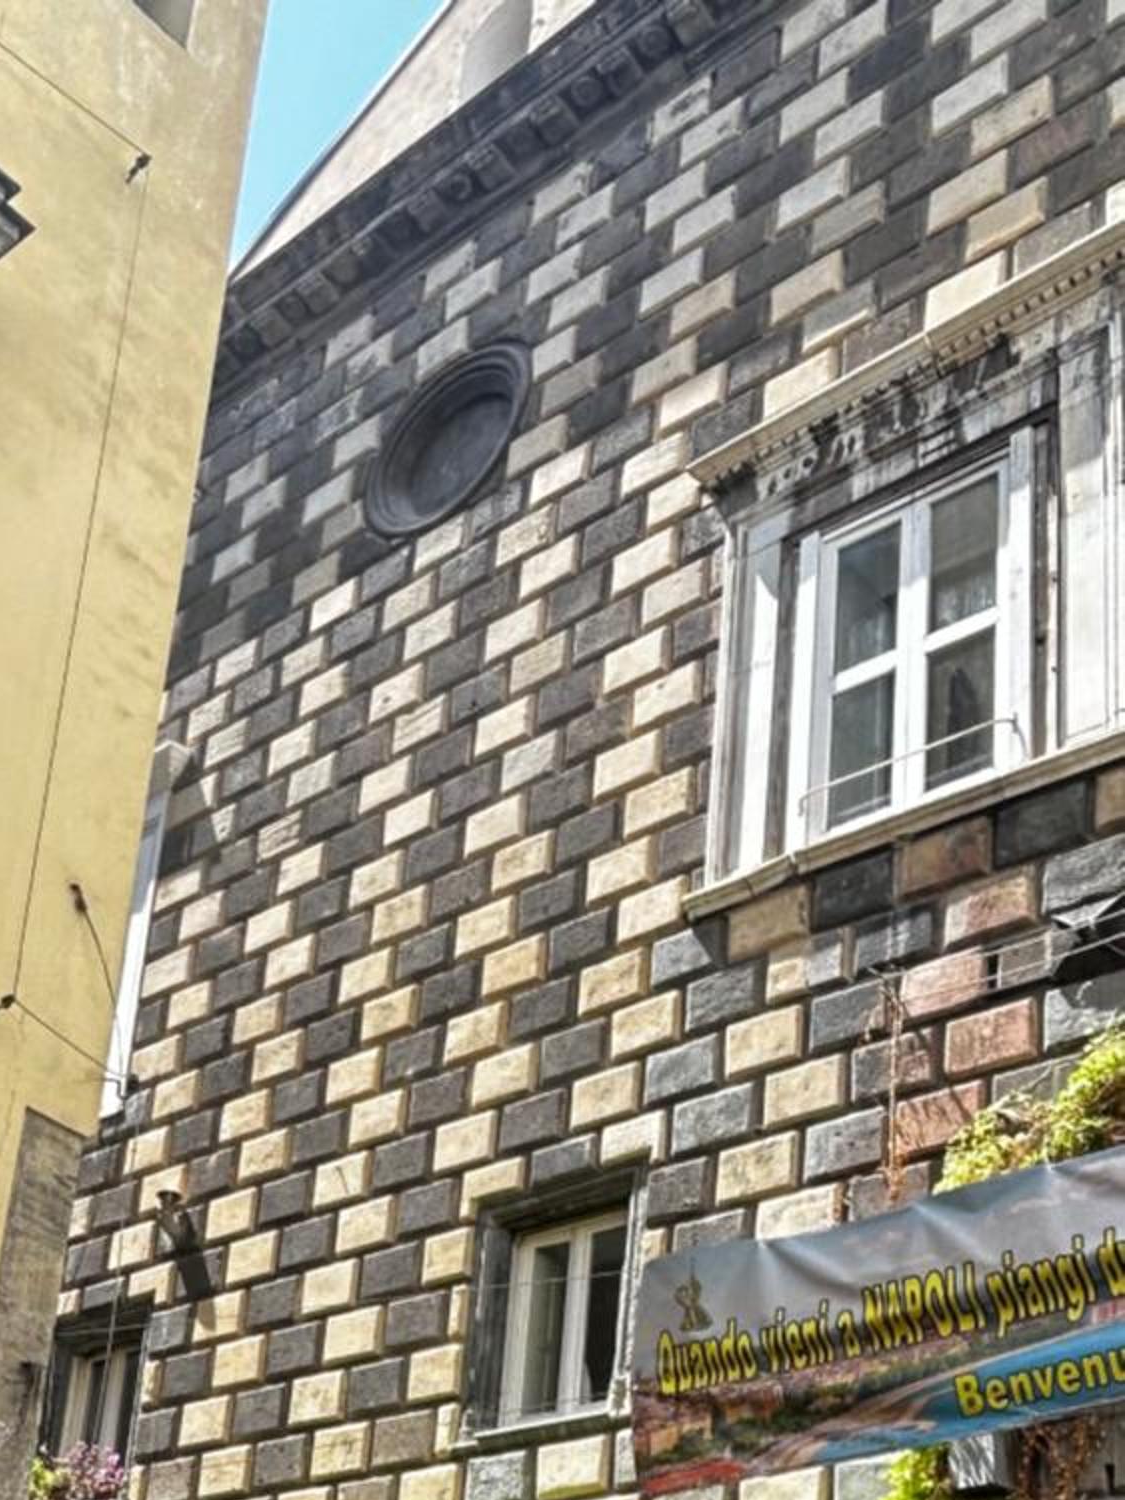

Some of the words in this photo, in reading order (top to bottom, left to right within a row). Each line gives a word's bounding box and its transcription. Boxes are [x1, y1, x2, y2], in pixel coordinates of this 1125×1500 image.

[657, 1317, 758, 1395] Quando
[760, 1299, 834, 1374] vieni
[837, 1309, 861, 1358] a
[862, 1260, 986, 1353] NAPOLI
[985, 1232, 1096, 1340] piangi
